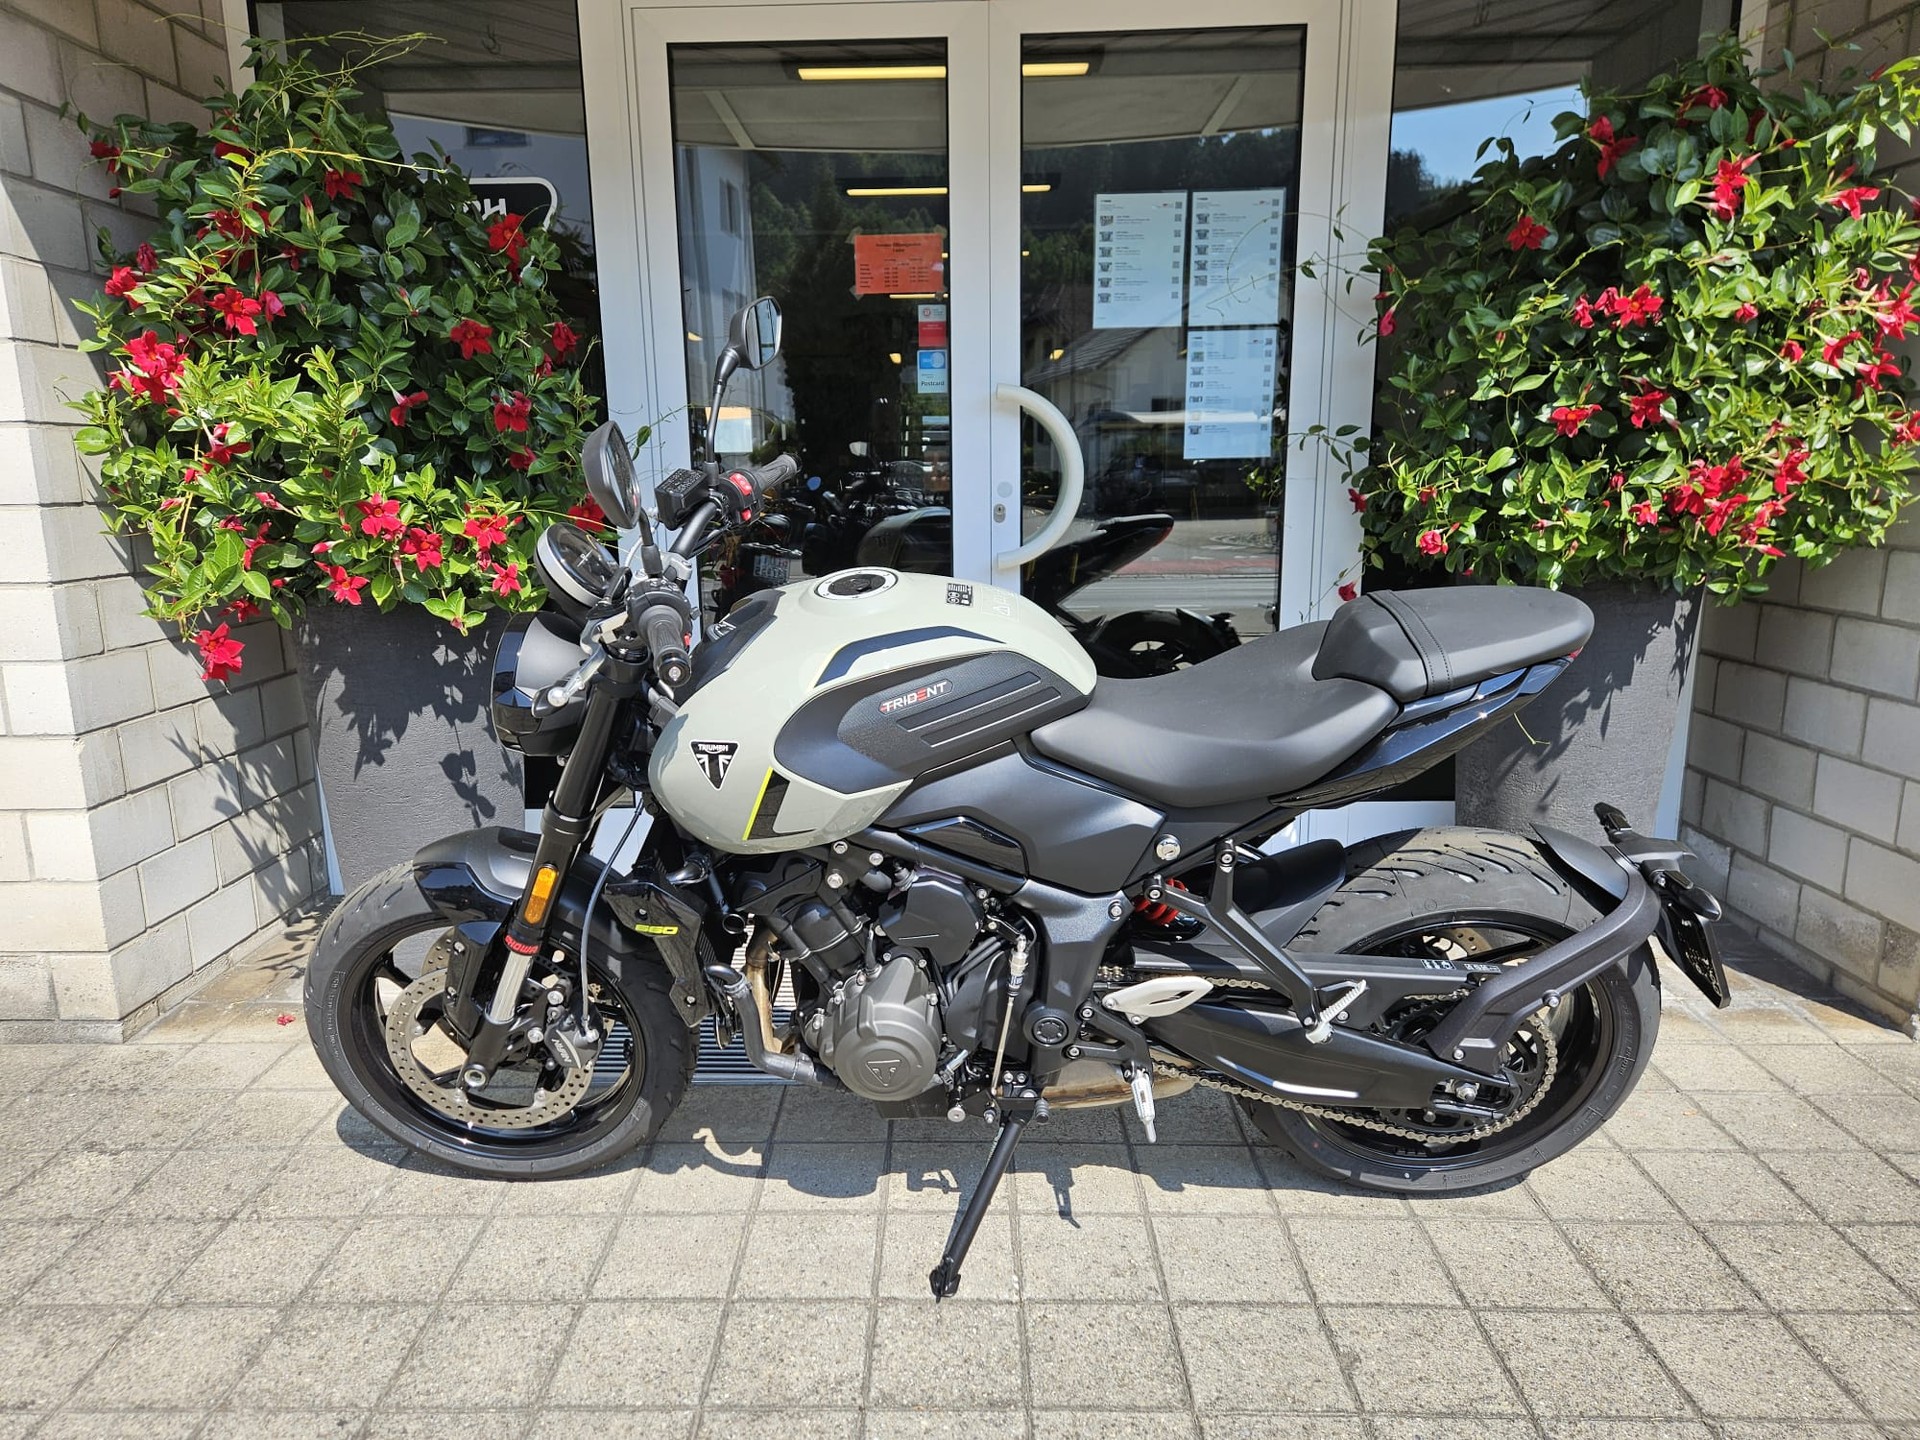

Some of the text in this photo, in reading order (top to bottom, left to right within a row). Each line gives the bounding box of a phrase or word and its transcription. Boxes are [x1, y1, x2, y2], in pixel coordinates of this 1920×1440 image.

[881, 682, 947, 711] TRIDENT
[698, 744, 728, 752] TRIUMPH
[505, 935, 539, 954] SHOWA
